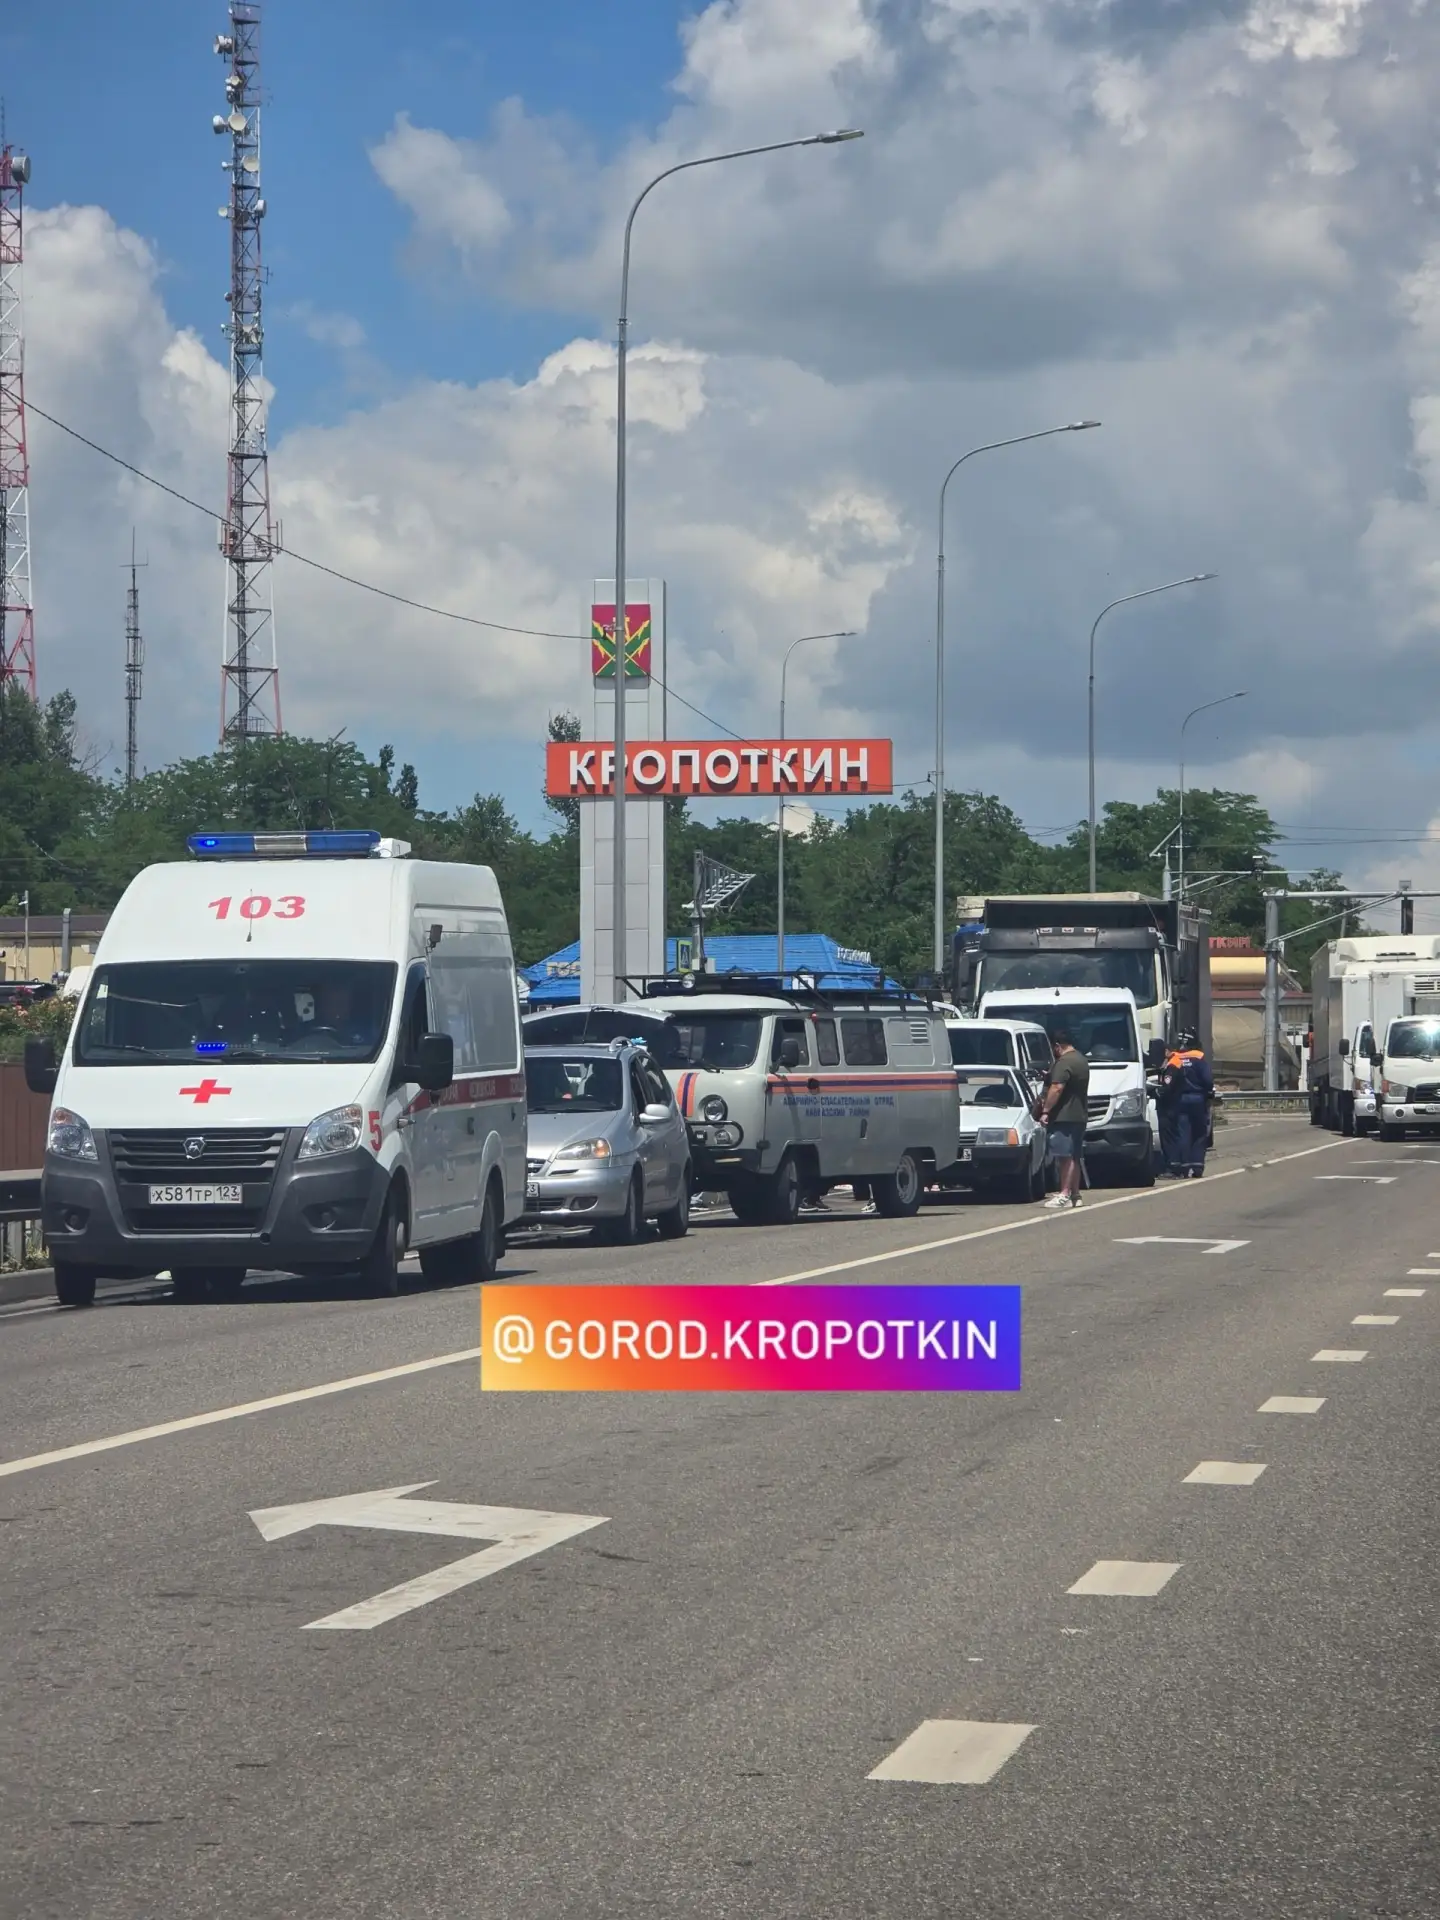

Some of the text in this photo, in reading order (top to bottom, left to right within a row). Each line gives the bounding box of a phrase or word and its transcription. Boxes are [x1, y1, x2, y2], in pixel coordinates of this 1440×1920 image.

[568, 747, 869, 786] КРОПОТКИН
[207, 895, 306, 920] 103
[368, 1110, 382, 1152] 5
[215, 1185, 238, 1198] 123
